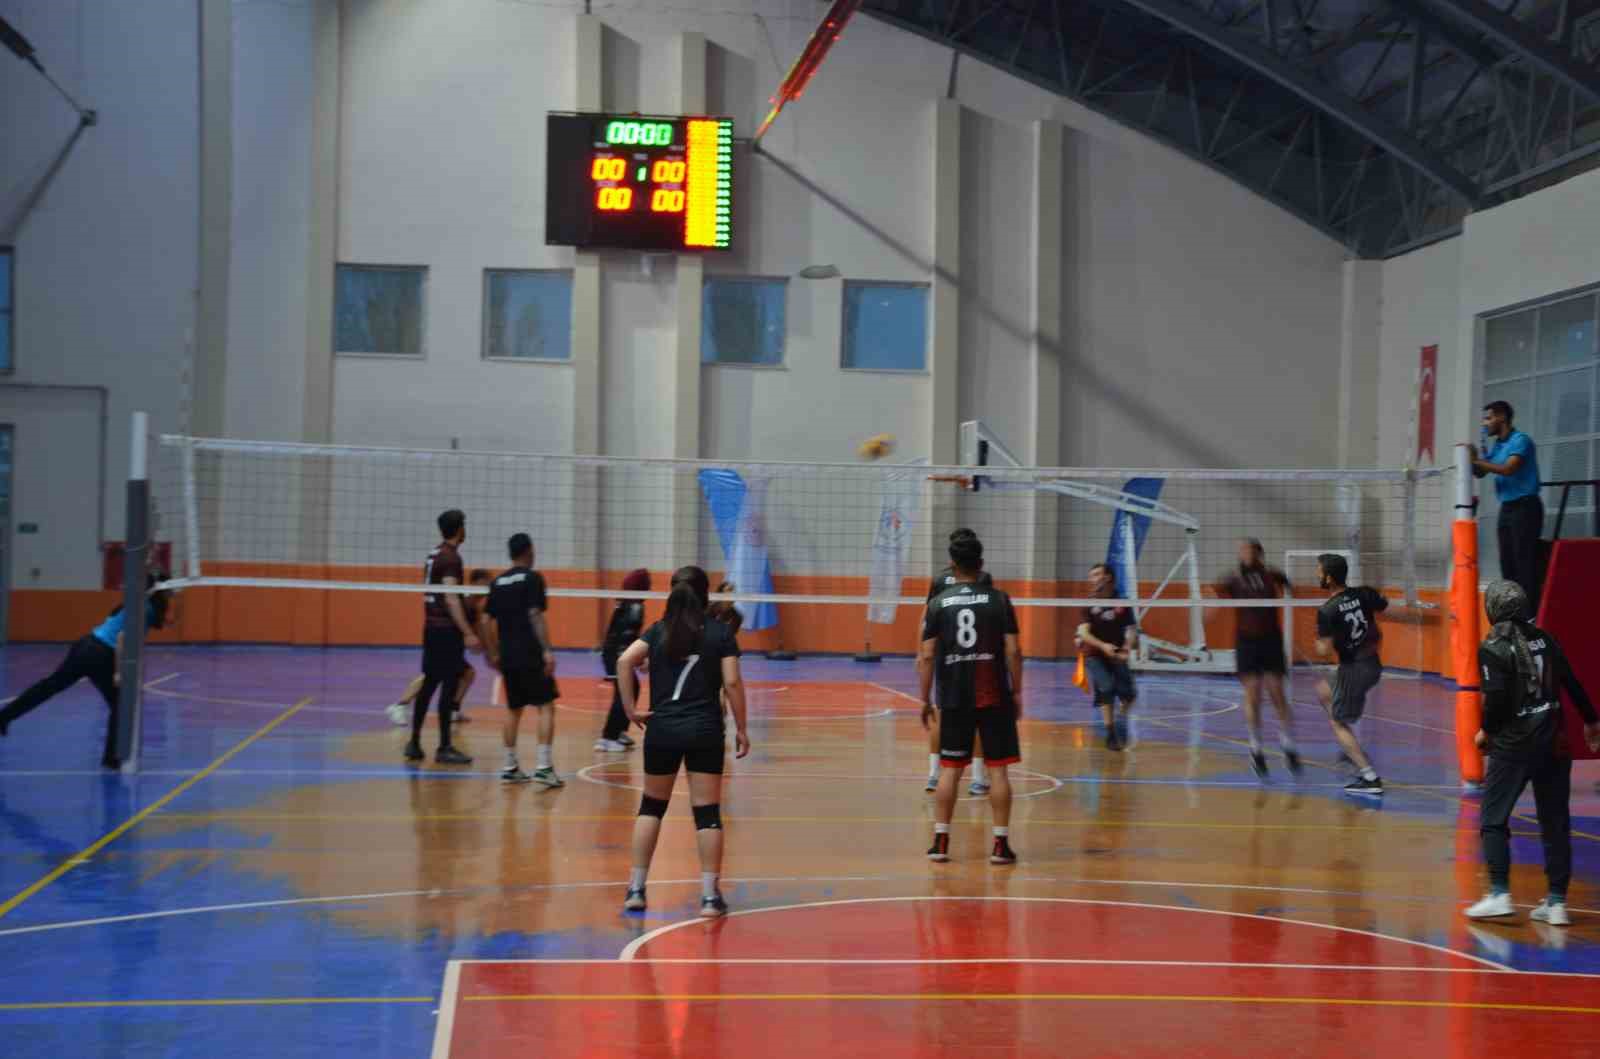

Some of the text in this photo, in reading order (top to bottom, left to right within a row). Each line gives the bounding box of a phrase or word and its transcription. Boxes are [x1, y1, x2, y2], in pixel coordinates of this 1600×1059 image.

[592, 158, 626, 181] 00
[652, 161, 686, 183] 00
[597, 187, 632, 210] 00
[651, 189, 685, 212] 00
[956, 608, 977, 649] 8
